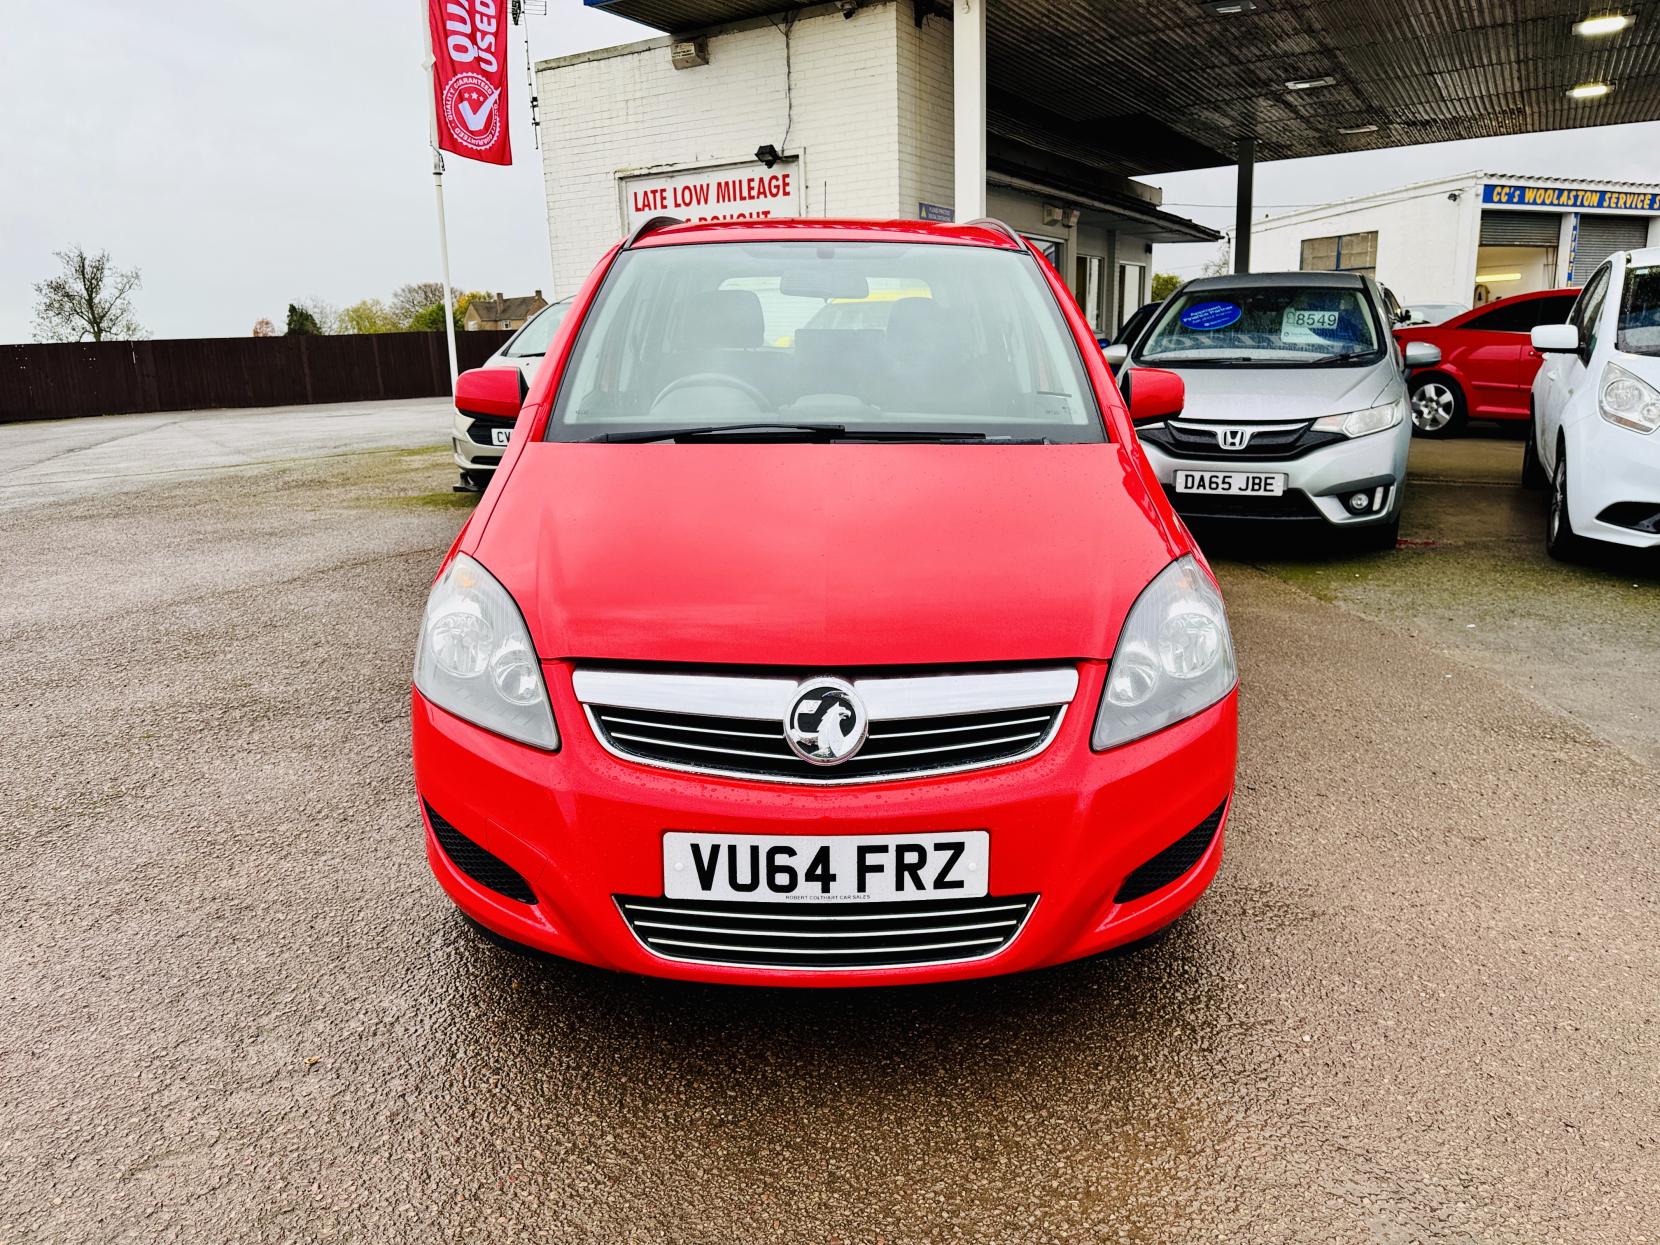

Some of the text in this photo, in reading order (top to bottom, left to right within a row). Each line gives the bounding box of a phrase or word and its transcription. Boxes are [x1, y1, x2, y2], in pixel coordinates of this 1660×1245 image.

[446, 77, 493, 120] QUALITY GUARANTEED
[633, 173, 791, 212] LATE LOW MILEAGE
[1524, 188, 1599, 207] WOOLASTON
[1603, 193, 1652, 209] SERVICE
[1183, 473, 1275, 493] DA65 JBE
[690, 841, 966, 893] VU64 FRZ
